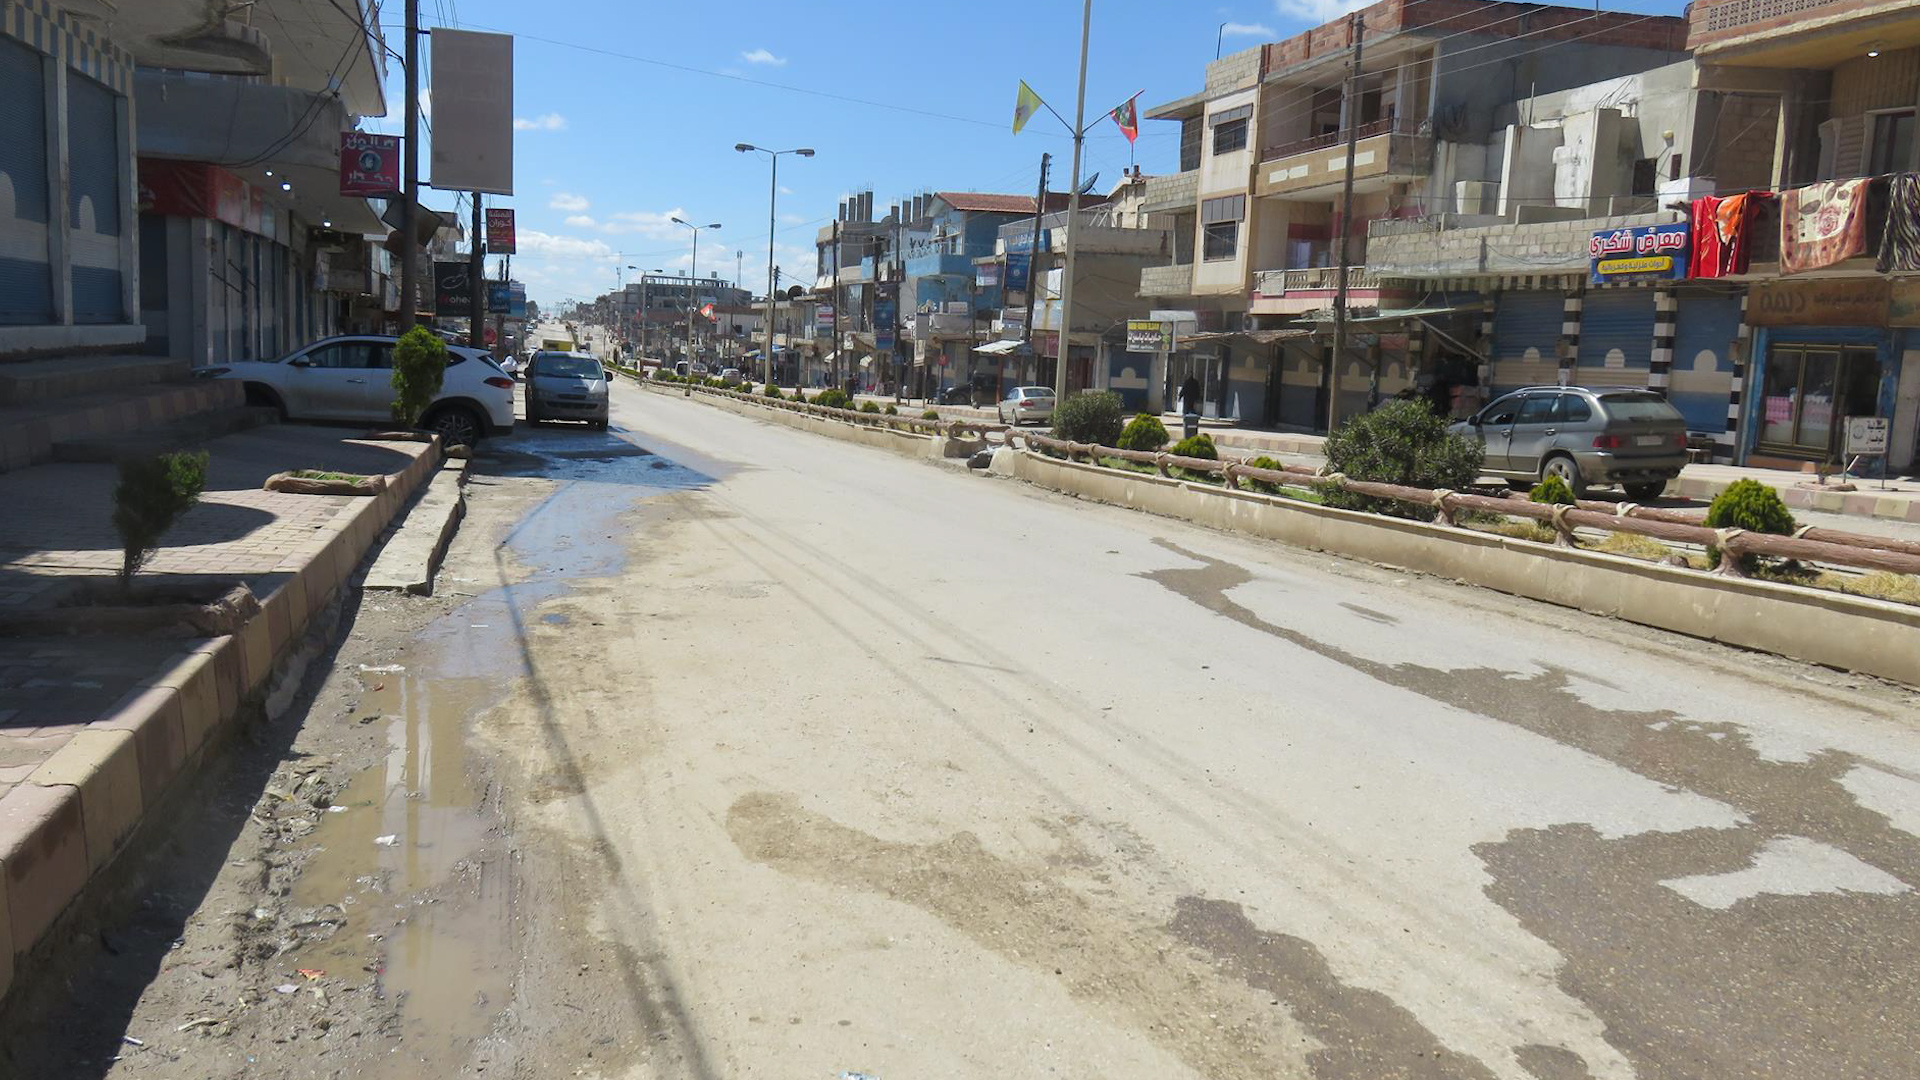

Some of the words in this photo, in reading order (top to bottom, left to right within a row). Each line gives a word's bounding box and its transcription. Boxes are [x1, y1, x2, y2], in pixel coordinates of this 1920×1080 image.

[346, 134, 394, 150] صالون
[1589, 230, 1632, 259] شكري
[1636, 227, 1686, 254] معرض
